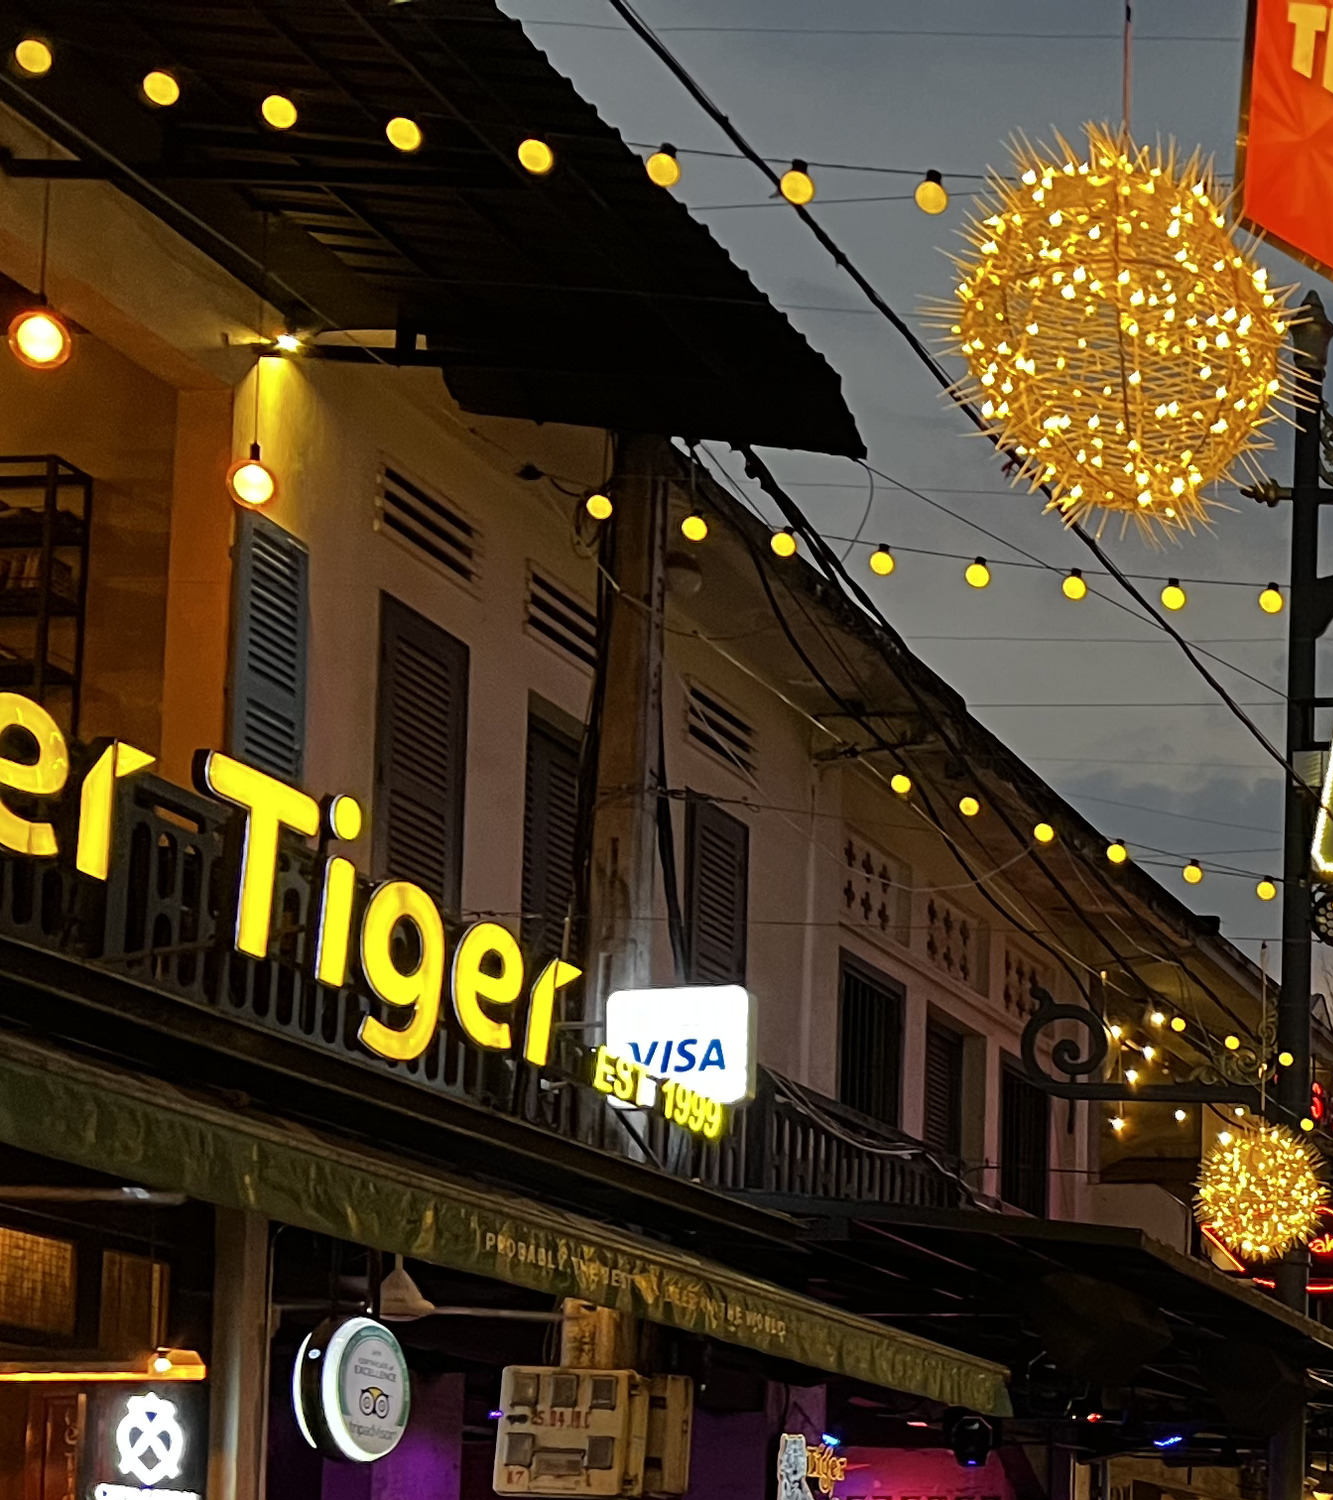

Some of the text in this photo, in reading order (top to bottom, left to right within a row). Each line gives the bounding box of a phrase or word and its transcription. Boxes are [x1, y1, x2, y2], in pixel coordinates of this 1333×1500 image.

[200, 749, 583, 1067] Tiger
[592, 1045, 723, 1139] EST 1999
[626, 1038, 726, 1074] VISA
